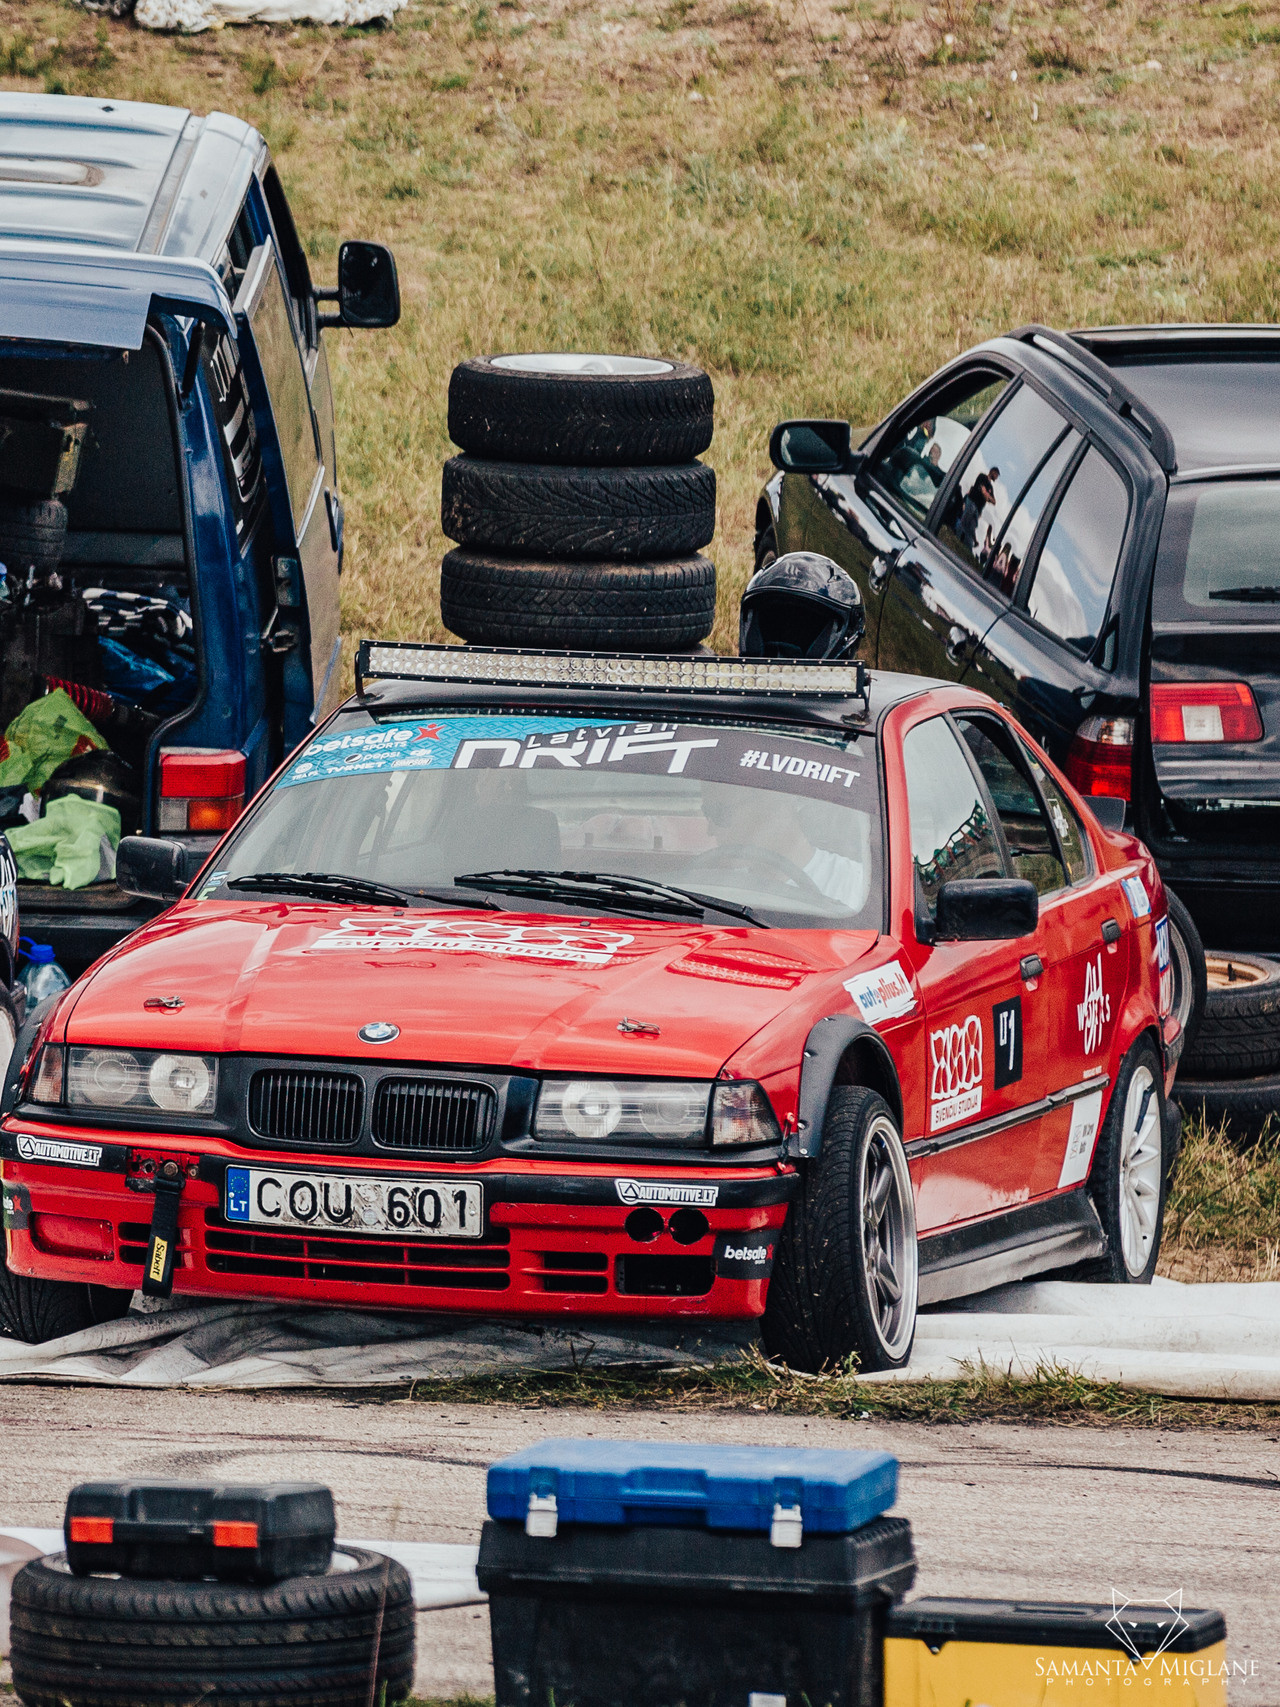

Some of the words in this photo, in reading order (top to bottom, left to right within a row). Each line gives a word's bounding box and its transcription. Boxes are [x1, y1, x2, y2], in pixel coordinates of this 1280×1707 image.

[302, 727, 414, 757] betsafe
[362, 741, 407, 751] SPORTS
[363, 751, 400, 762] pepsi
[454, 731, 720, 774] DRIFT
[739, 748, 861, 789] #LVDRIFT
[470, 943, 587, 960] STUDIJA
[33, 1141, 100, 1163] AUTOMOTIVE.LT
[257, 1177, 353, 1224] COU
[387, 1186, 467, 1229] 601
[638, 1187, 715, 1203] AUTOMOTIVE.LT
[229, 1197, 248, 1213] LT
[153, 1243, 166, 1276] Sabelt
[724, 1245, 767, 1261] betsafe
